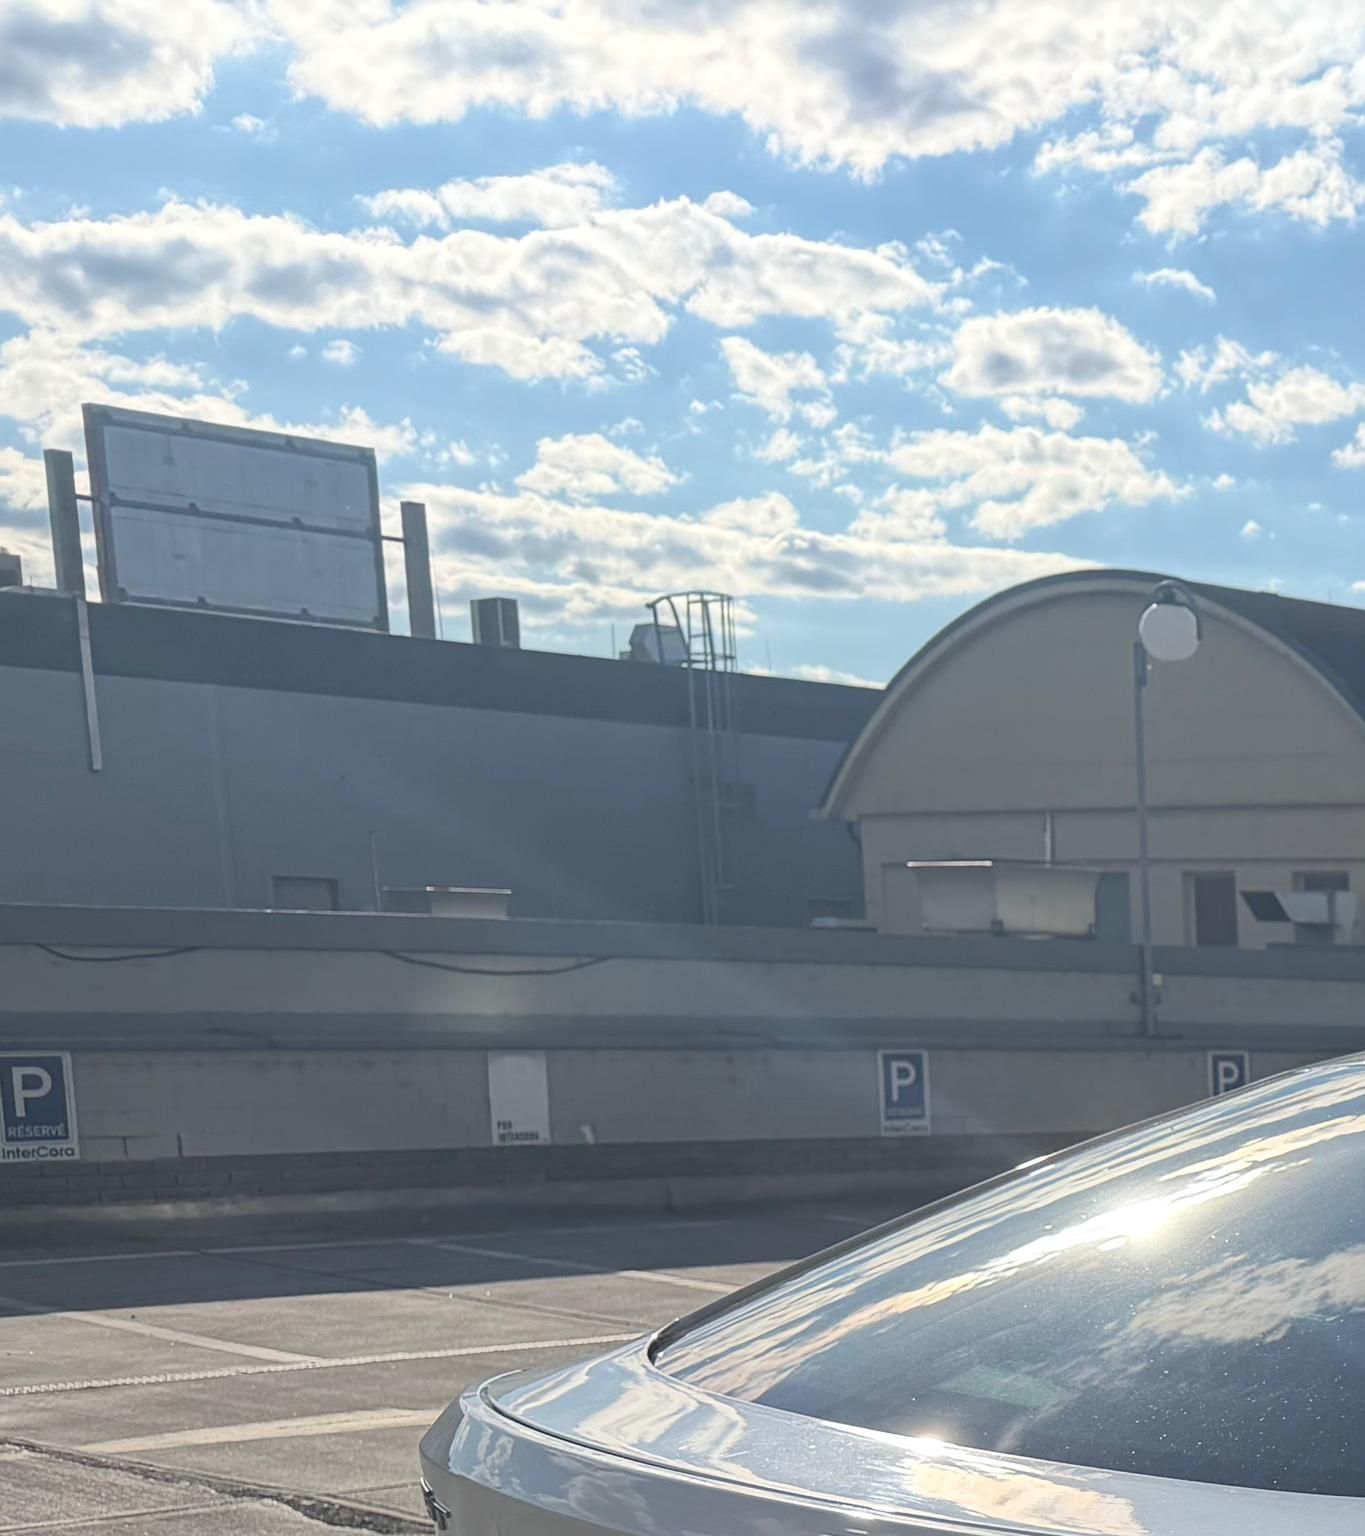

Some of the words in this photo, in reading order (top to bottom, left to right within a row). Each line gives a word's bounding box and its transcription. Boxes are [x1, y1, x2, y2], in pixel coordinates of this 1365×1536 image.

[12, 1066, 52, 1118] P
[891, 1061, 917, 1102] P
[1218, 1060, 1239, 1094] P
[8, 1122, 67, 1138] RÉSERVÉ
[1, 1145, 76, 1159] InterCora
